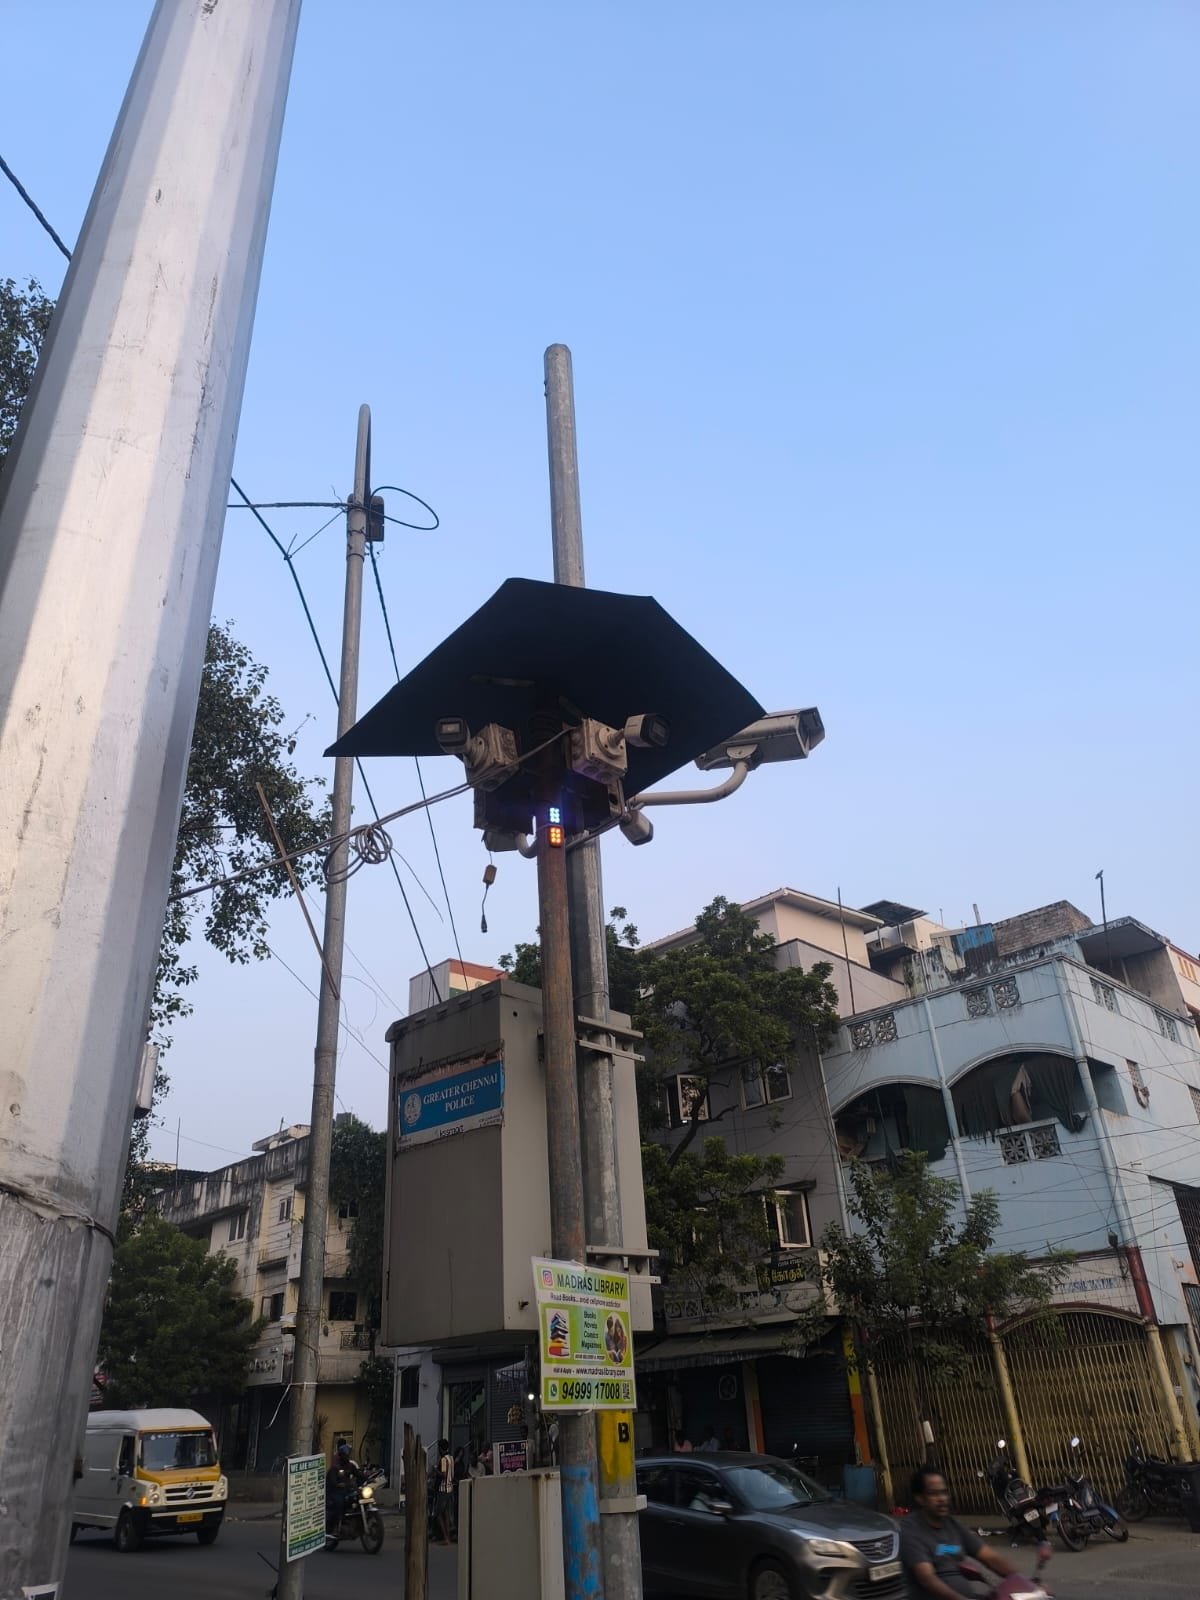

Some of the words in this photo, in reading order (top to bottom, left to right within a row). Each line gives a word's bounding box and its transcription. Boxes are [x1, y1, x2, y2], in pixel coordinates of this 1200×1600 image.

[423, 1086, 460, 1105] GREATER
[461, 1073, 498, 1094] CHENNAI
[445, 1095, 476, 1113] POLICE
[557, 1273, 593, 1292] MADRAS
[594, 1279, 625, 1297] LIBRARY
[584, 1310, 597, 1320] Books
[584, 1321, 598, 1329] Novels
[584, 1331, 599, 1339] Comics
[581, 1340, 602, 1350] Magazines
[576, 1367, 626, 1378] www.madraslibrary.com
[562, 1382, 592, 1400] 94999
[594, 1382, 620, 1400] 17008
[618, 1422, 630, 1443] B
